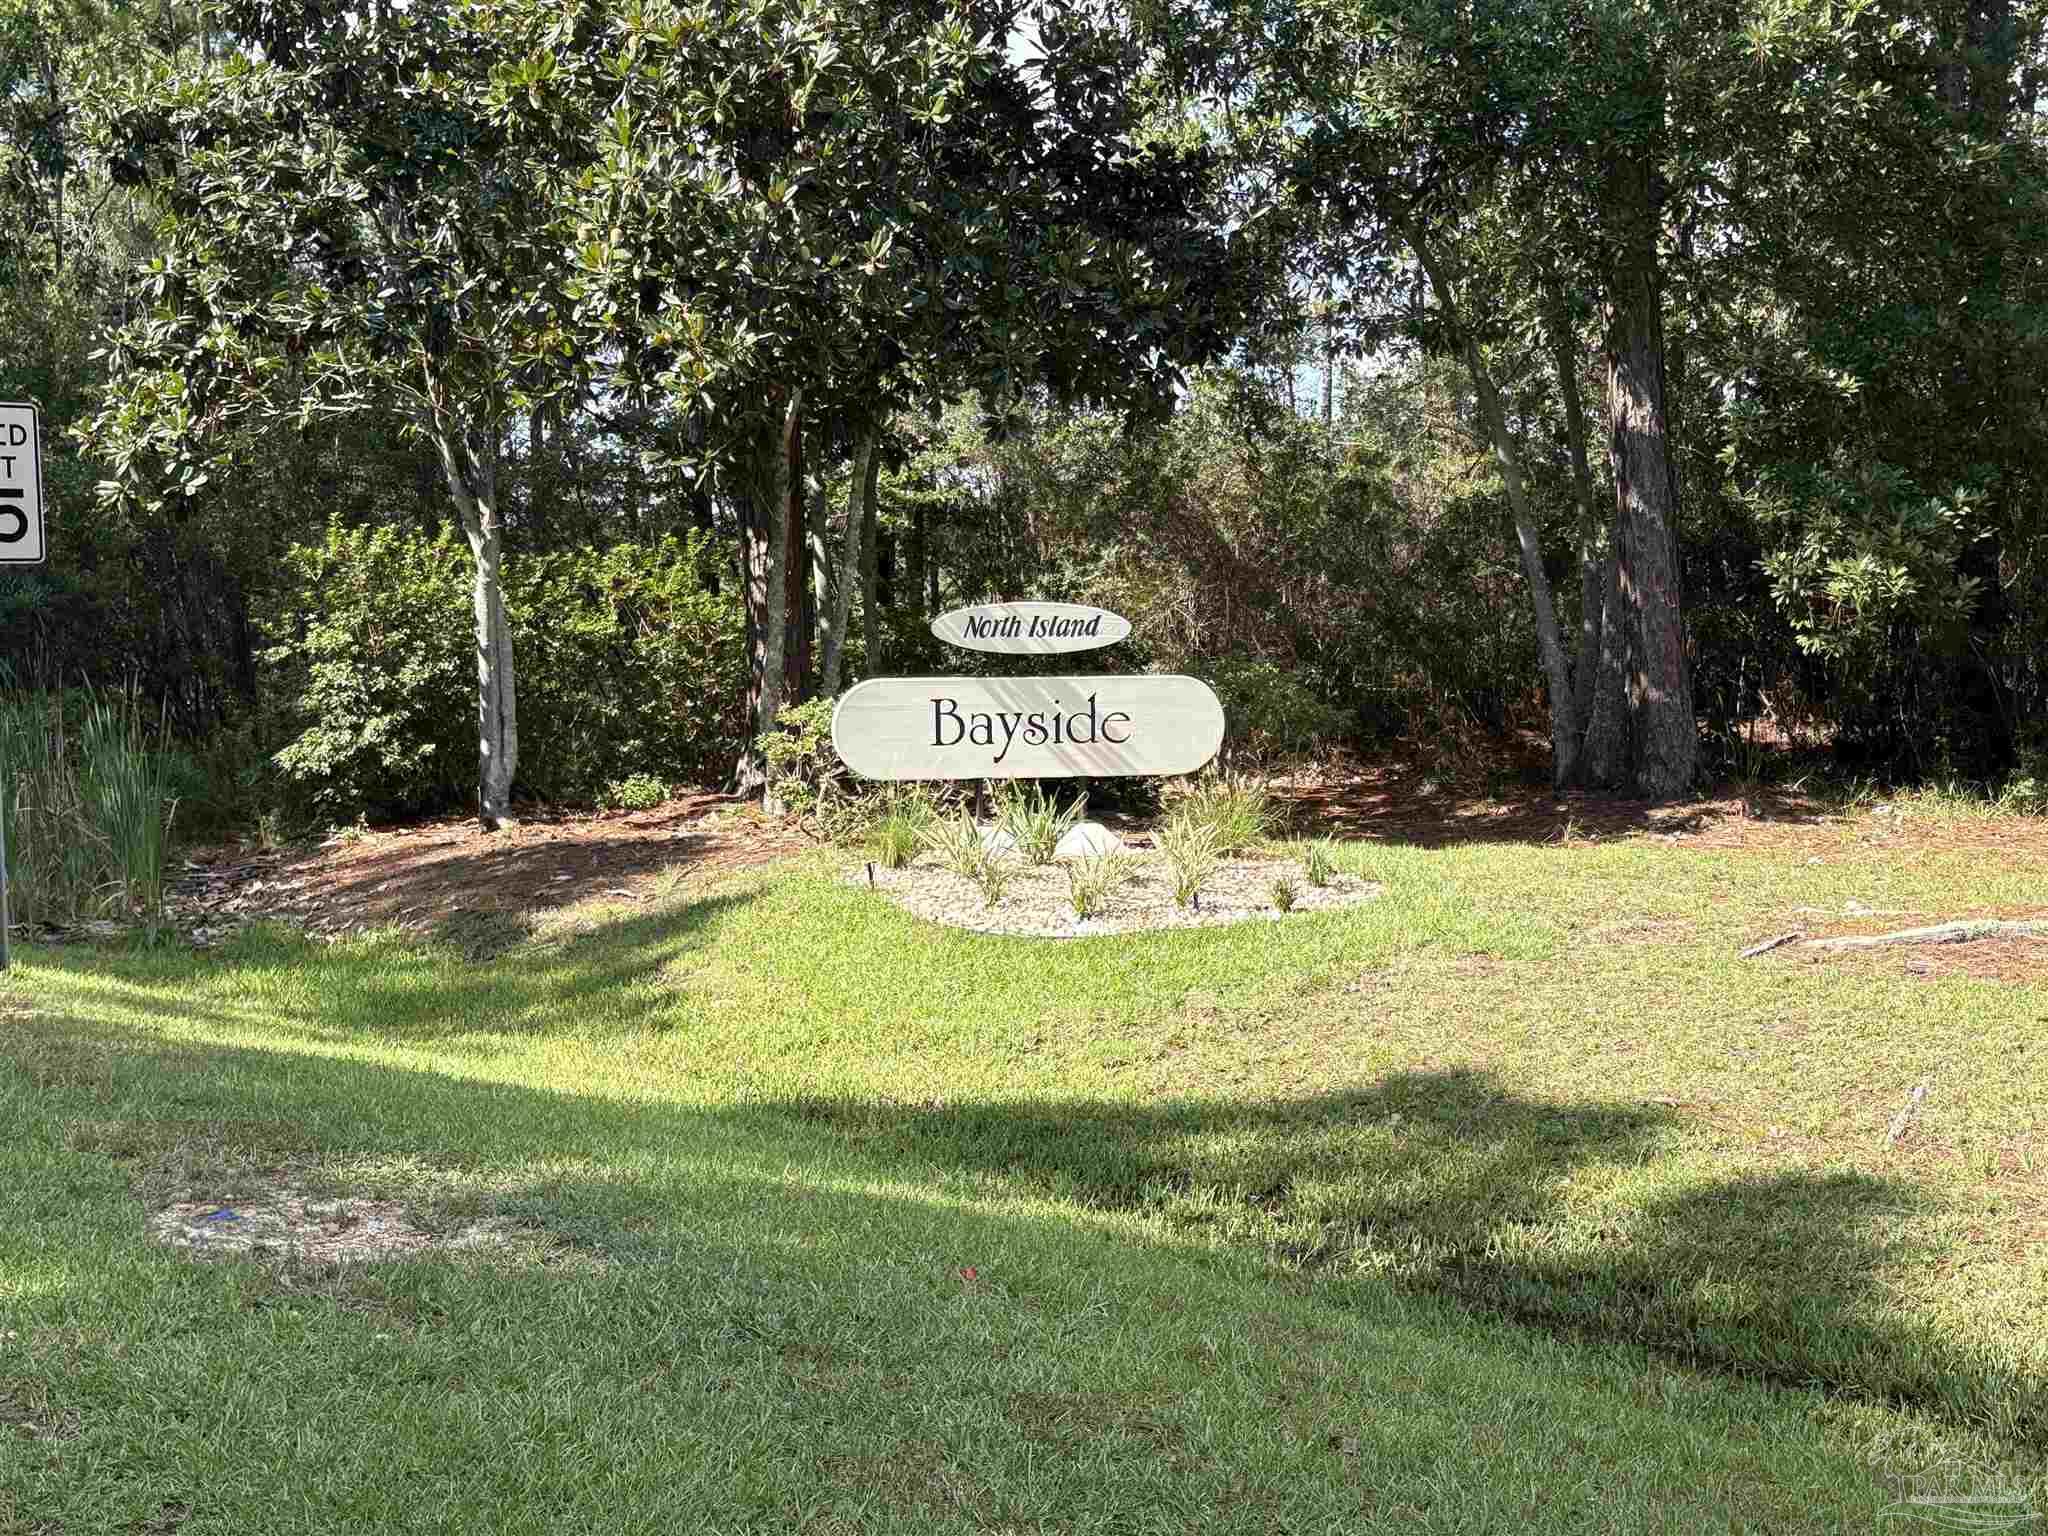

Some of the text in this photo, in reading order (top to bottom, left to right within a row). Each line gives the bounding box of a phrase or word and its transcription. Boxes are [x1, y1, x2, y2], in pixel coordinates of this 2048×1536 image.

[963, 615, 1102, 639] North Island
[930, 692, 1131, 763] Bayside
